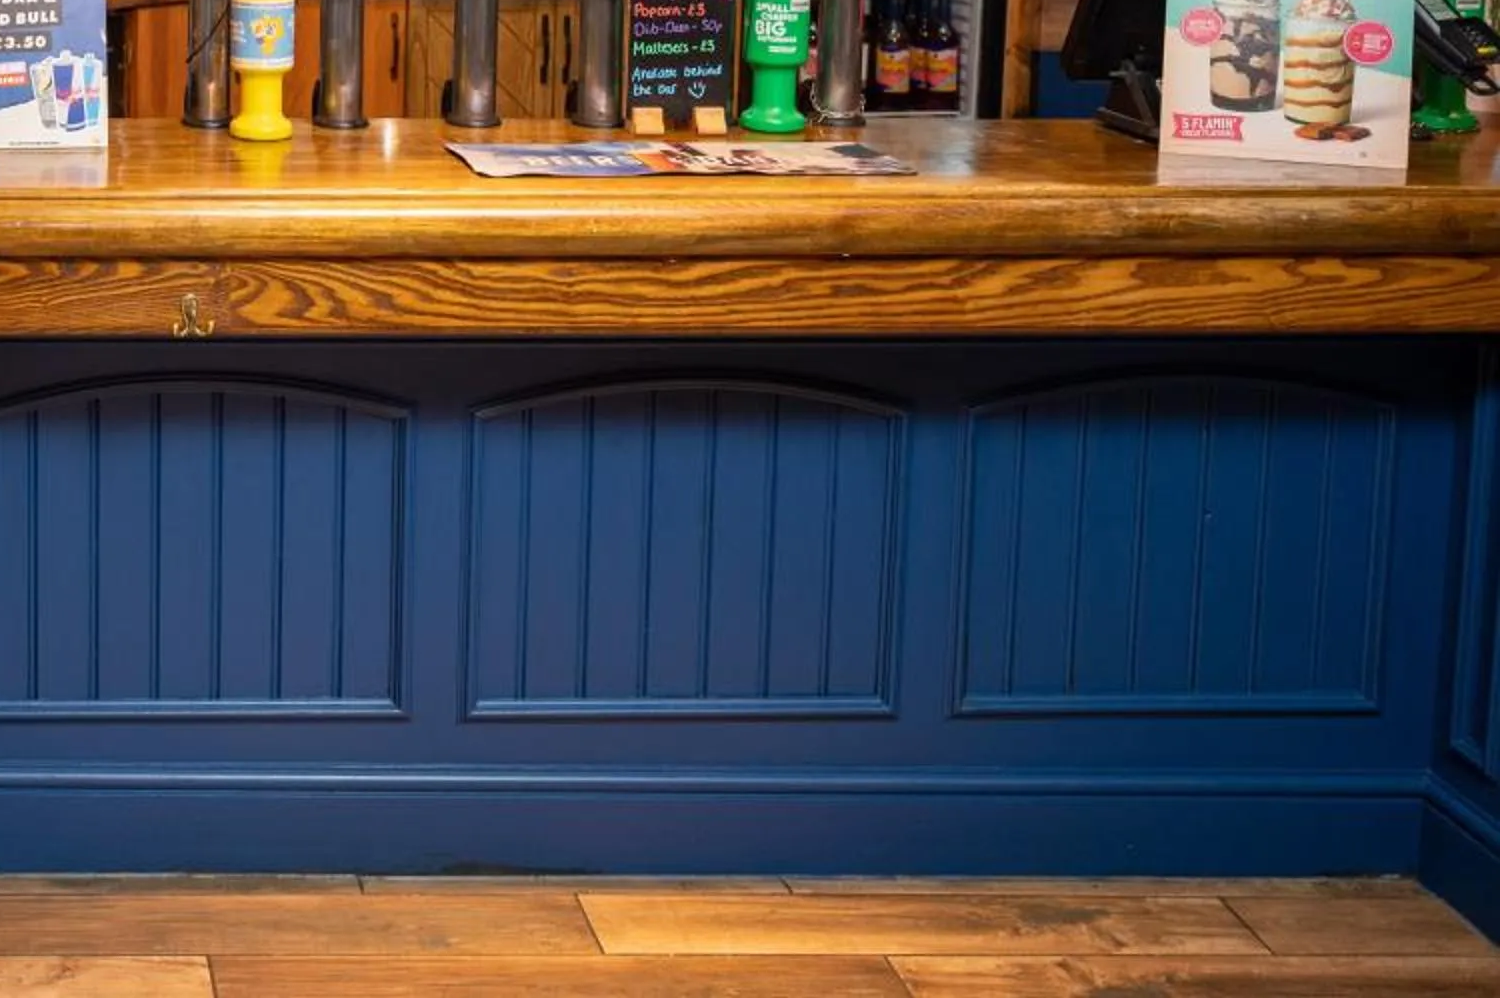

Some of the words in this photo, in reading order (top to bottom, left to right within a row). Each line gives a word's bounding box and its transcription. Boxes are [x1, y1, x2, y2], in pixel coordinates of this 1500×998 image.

[755, 2, 790, 13] SMALL
[15, 10, 59, 25] BULL
[755, 20, 787, 36] BIG
[632, 83, 653, 98] the
[1182, 117, 1190, 129] 5
[1192, 117, 1237, 131] FLAMIN'
